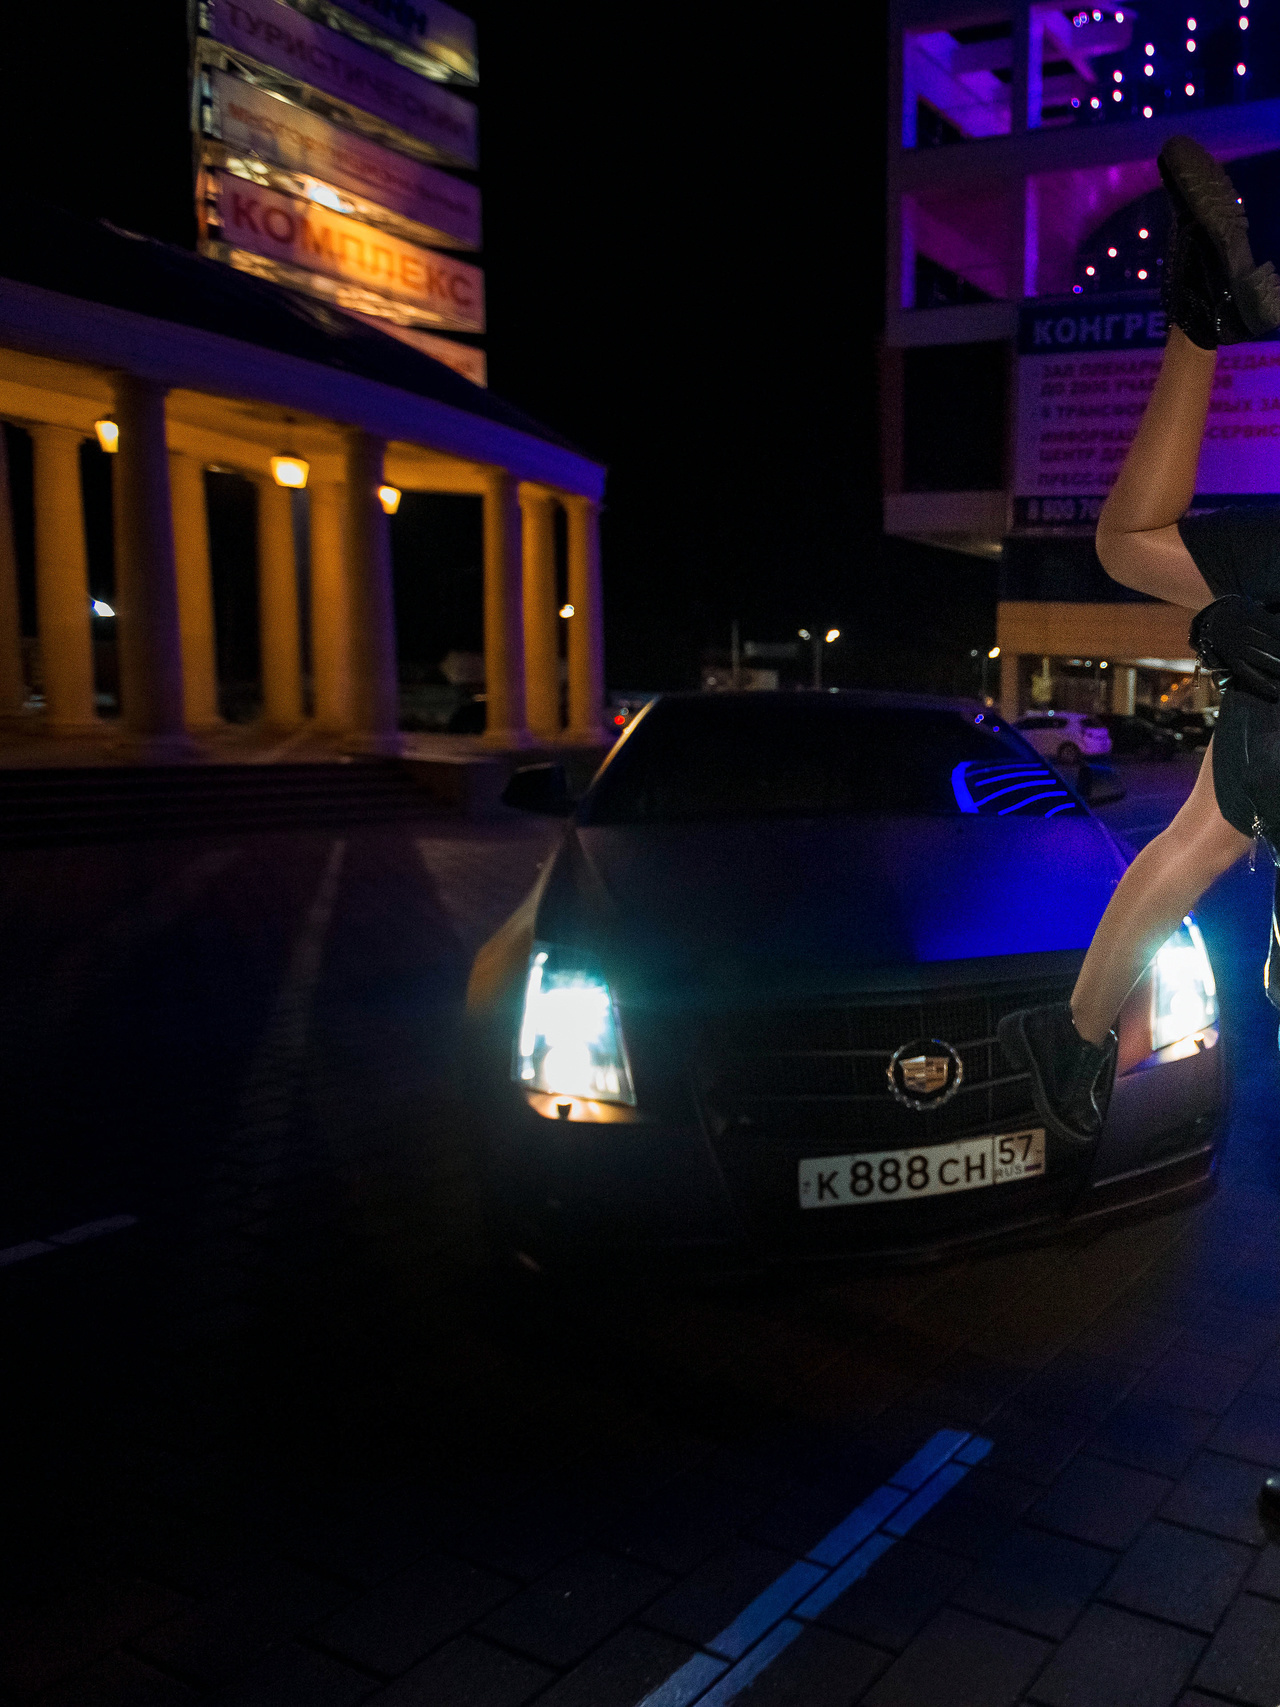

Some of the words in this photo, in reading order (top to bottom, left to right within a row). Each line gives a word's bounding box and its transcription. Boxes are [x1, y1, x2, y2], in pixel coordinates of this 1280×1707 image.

[232, 193, 474, 307] КОМПЛЕКС
[1032, 310, 1168, 346] КОНГРЕ
[1000, 1135, 1033, 1165] 57
